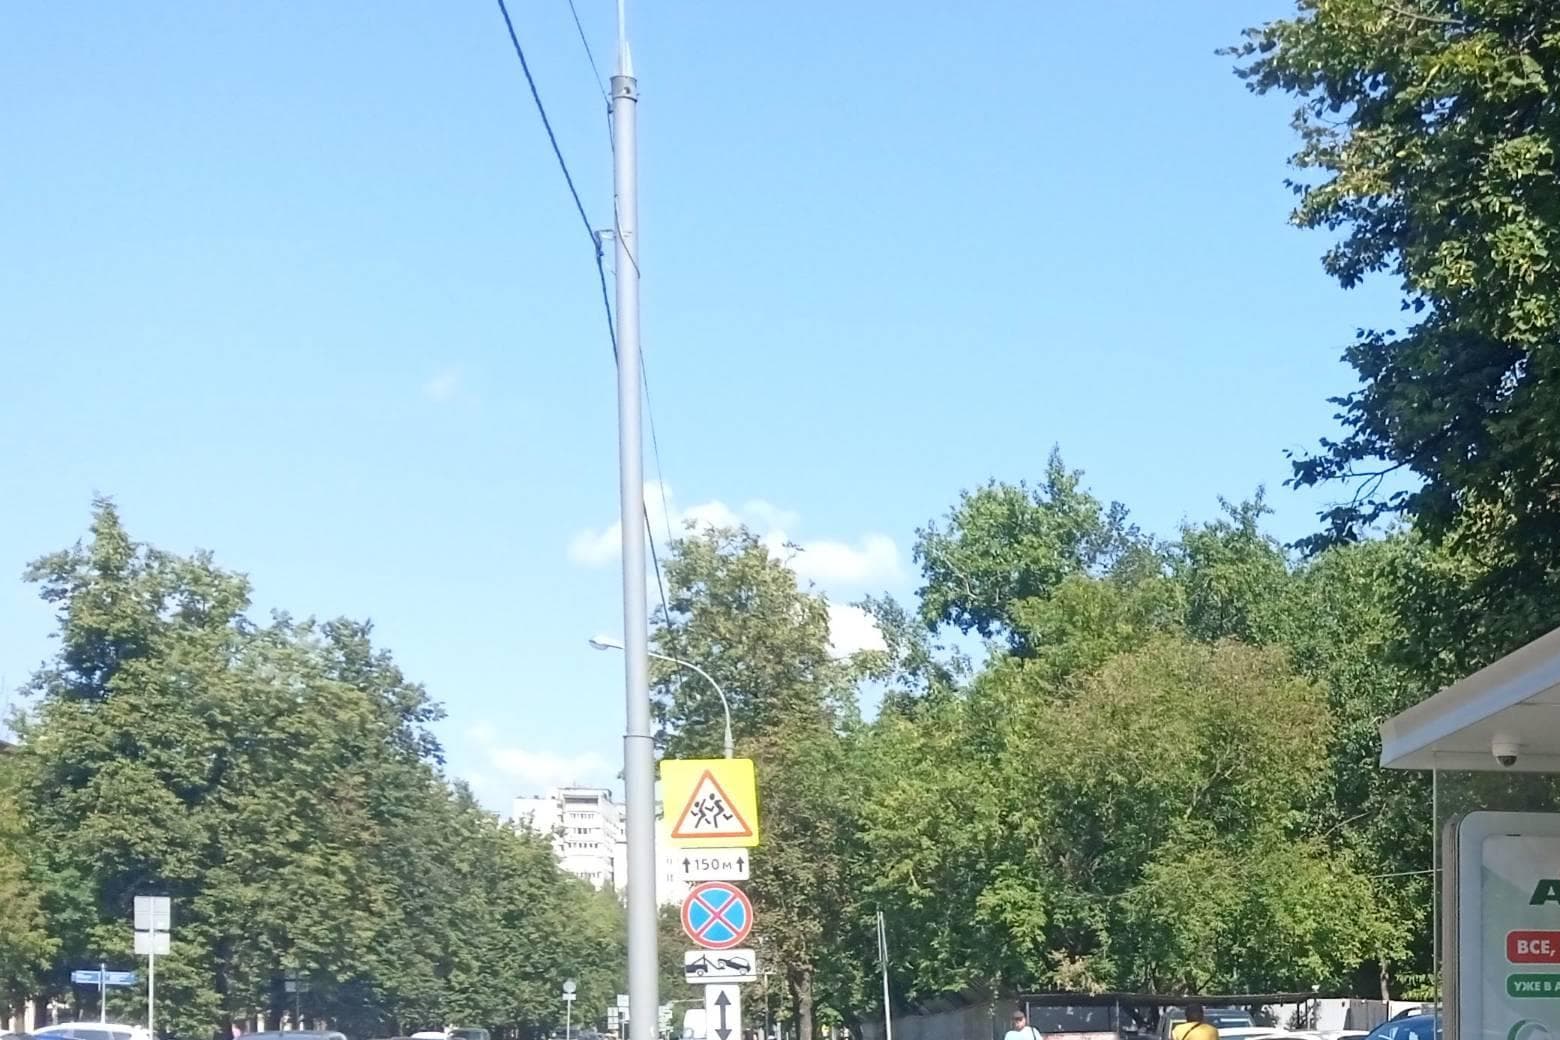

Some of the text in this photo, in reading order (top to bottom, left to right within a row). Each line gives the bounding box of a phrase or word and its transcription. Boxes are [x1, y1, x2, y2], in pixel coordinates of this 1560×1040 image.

[695, 858, 720, 871] 150
[1516, 940, 1556, 956] ВСЕ,
[1514, 981, 1541, 992] УЖЕ
[1543, 982, 1551, 991] В
